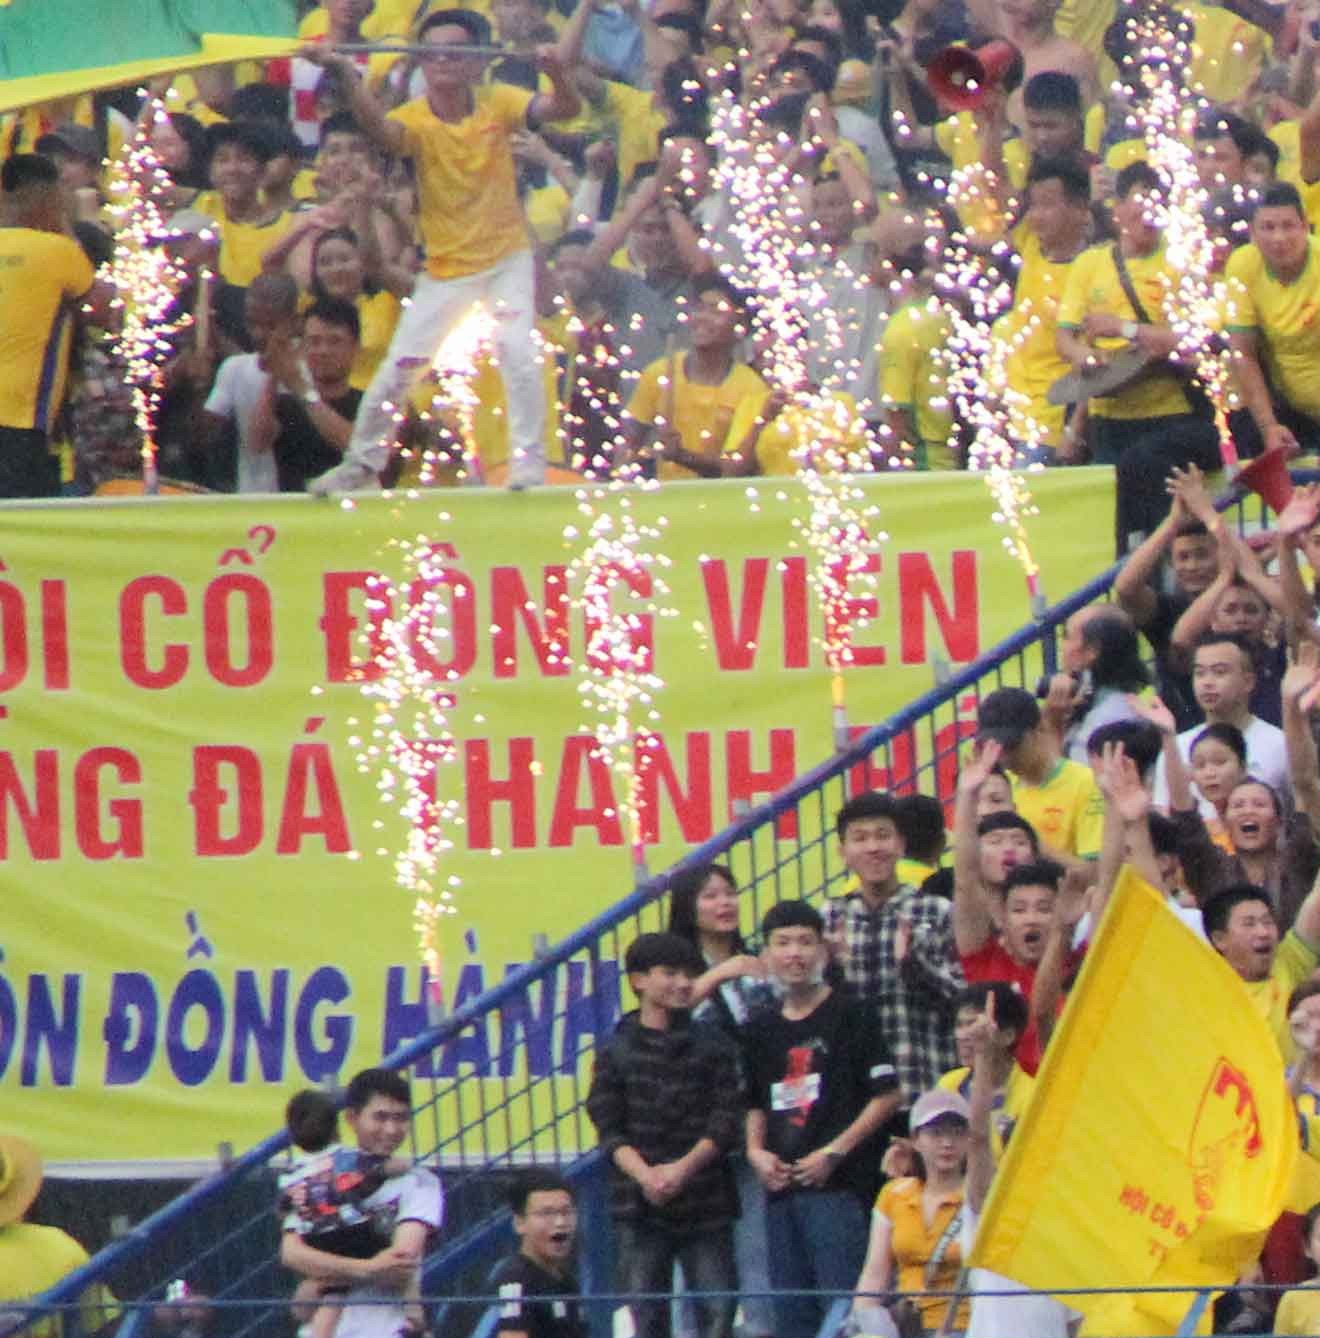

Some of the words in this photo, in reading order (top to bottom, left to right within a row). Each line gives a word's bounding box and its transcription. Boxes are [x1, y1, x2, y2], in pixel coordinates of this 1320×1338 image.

[118, 525, 274, 690] CỔ
[320, 543, 656, 708] ĐỘNG
[188, 717, 352, 857] ĐÁ
[397, 728, 799, 853] THANH
[103, 909, 354, 1087] ĐỒNG
